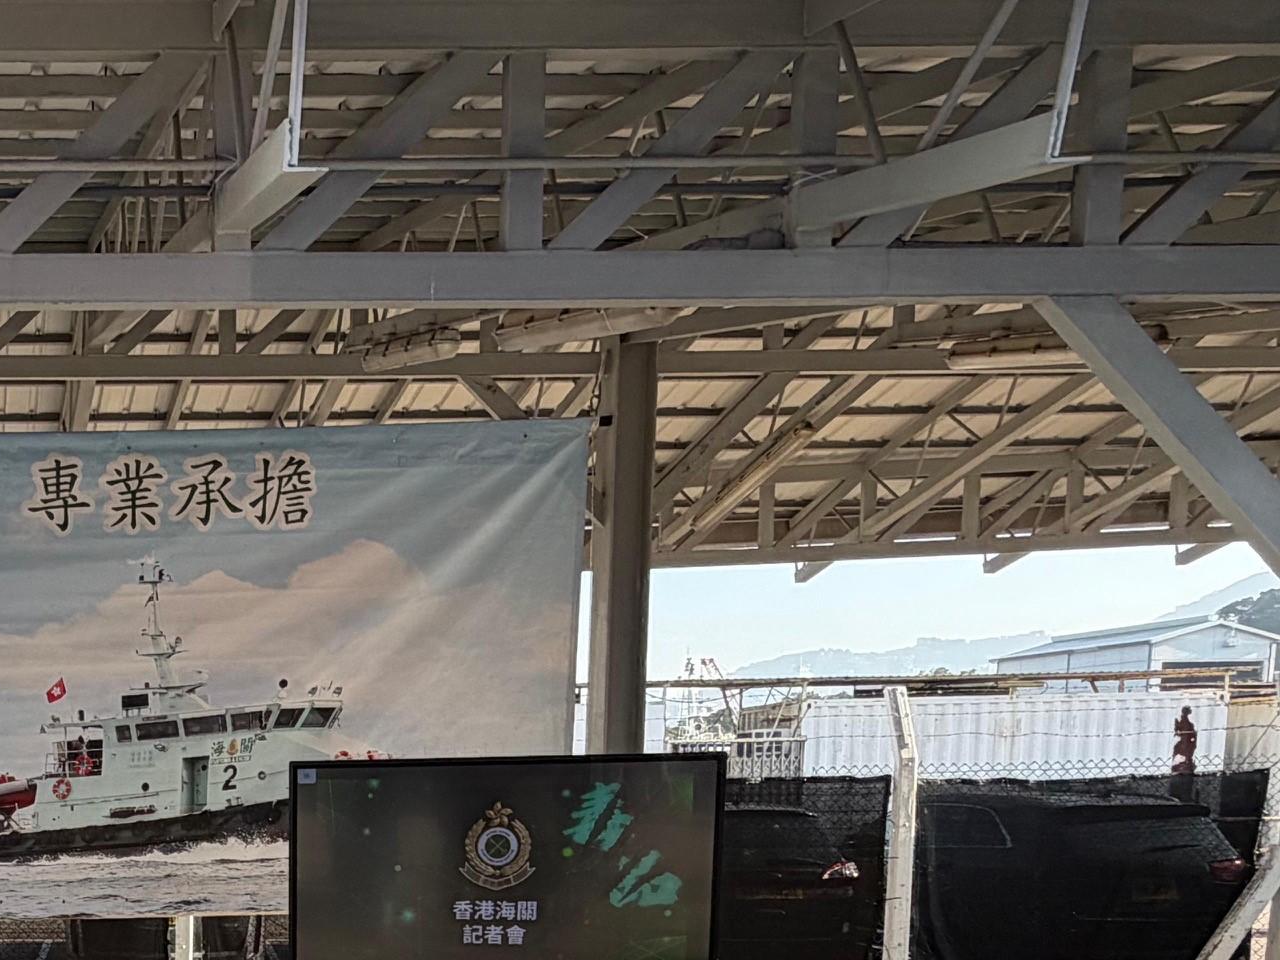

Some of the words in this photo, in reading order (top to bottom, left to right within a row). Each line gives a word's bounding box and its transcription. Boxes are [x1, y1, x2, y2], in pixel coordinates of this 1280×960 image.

[27, 455, 313, 532] 專業承擔
[222, 764, 238, 791] 2
[453, 900, 538, 921] 香港海關
[463, 924, 527, 945] 記者會
